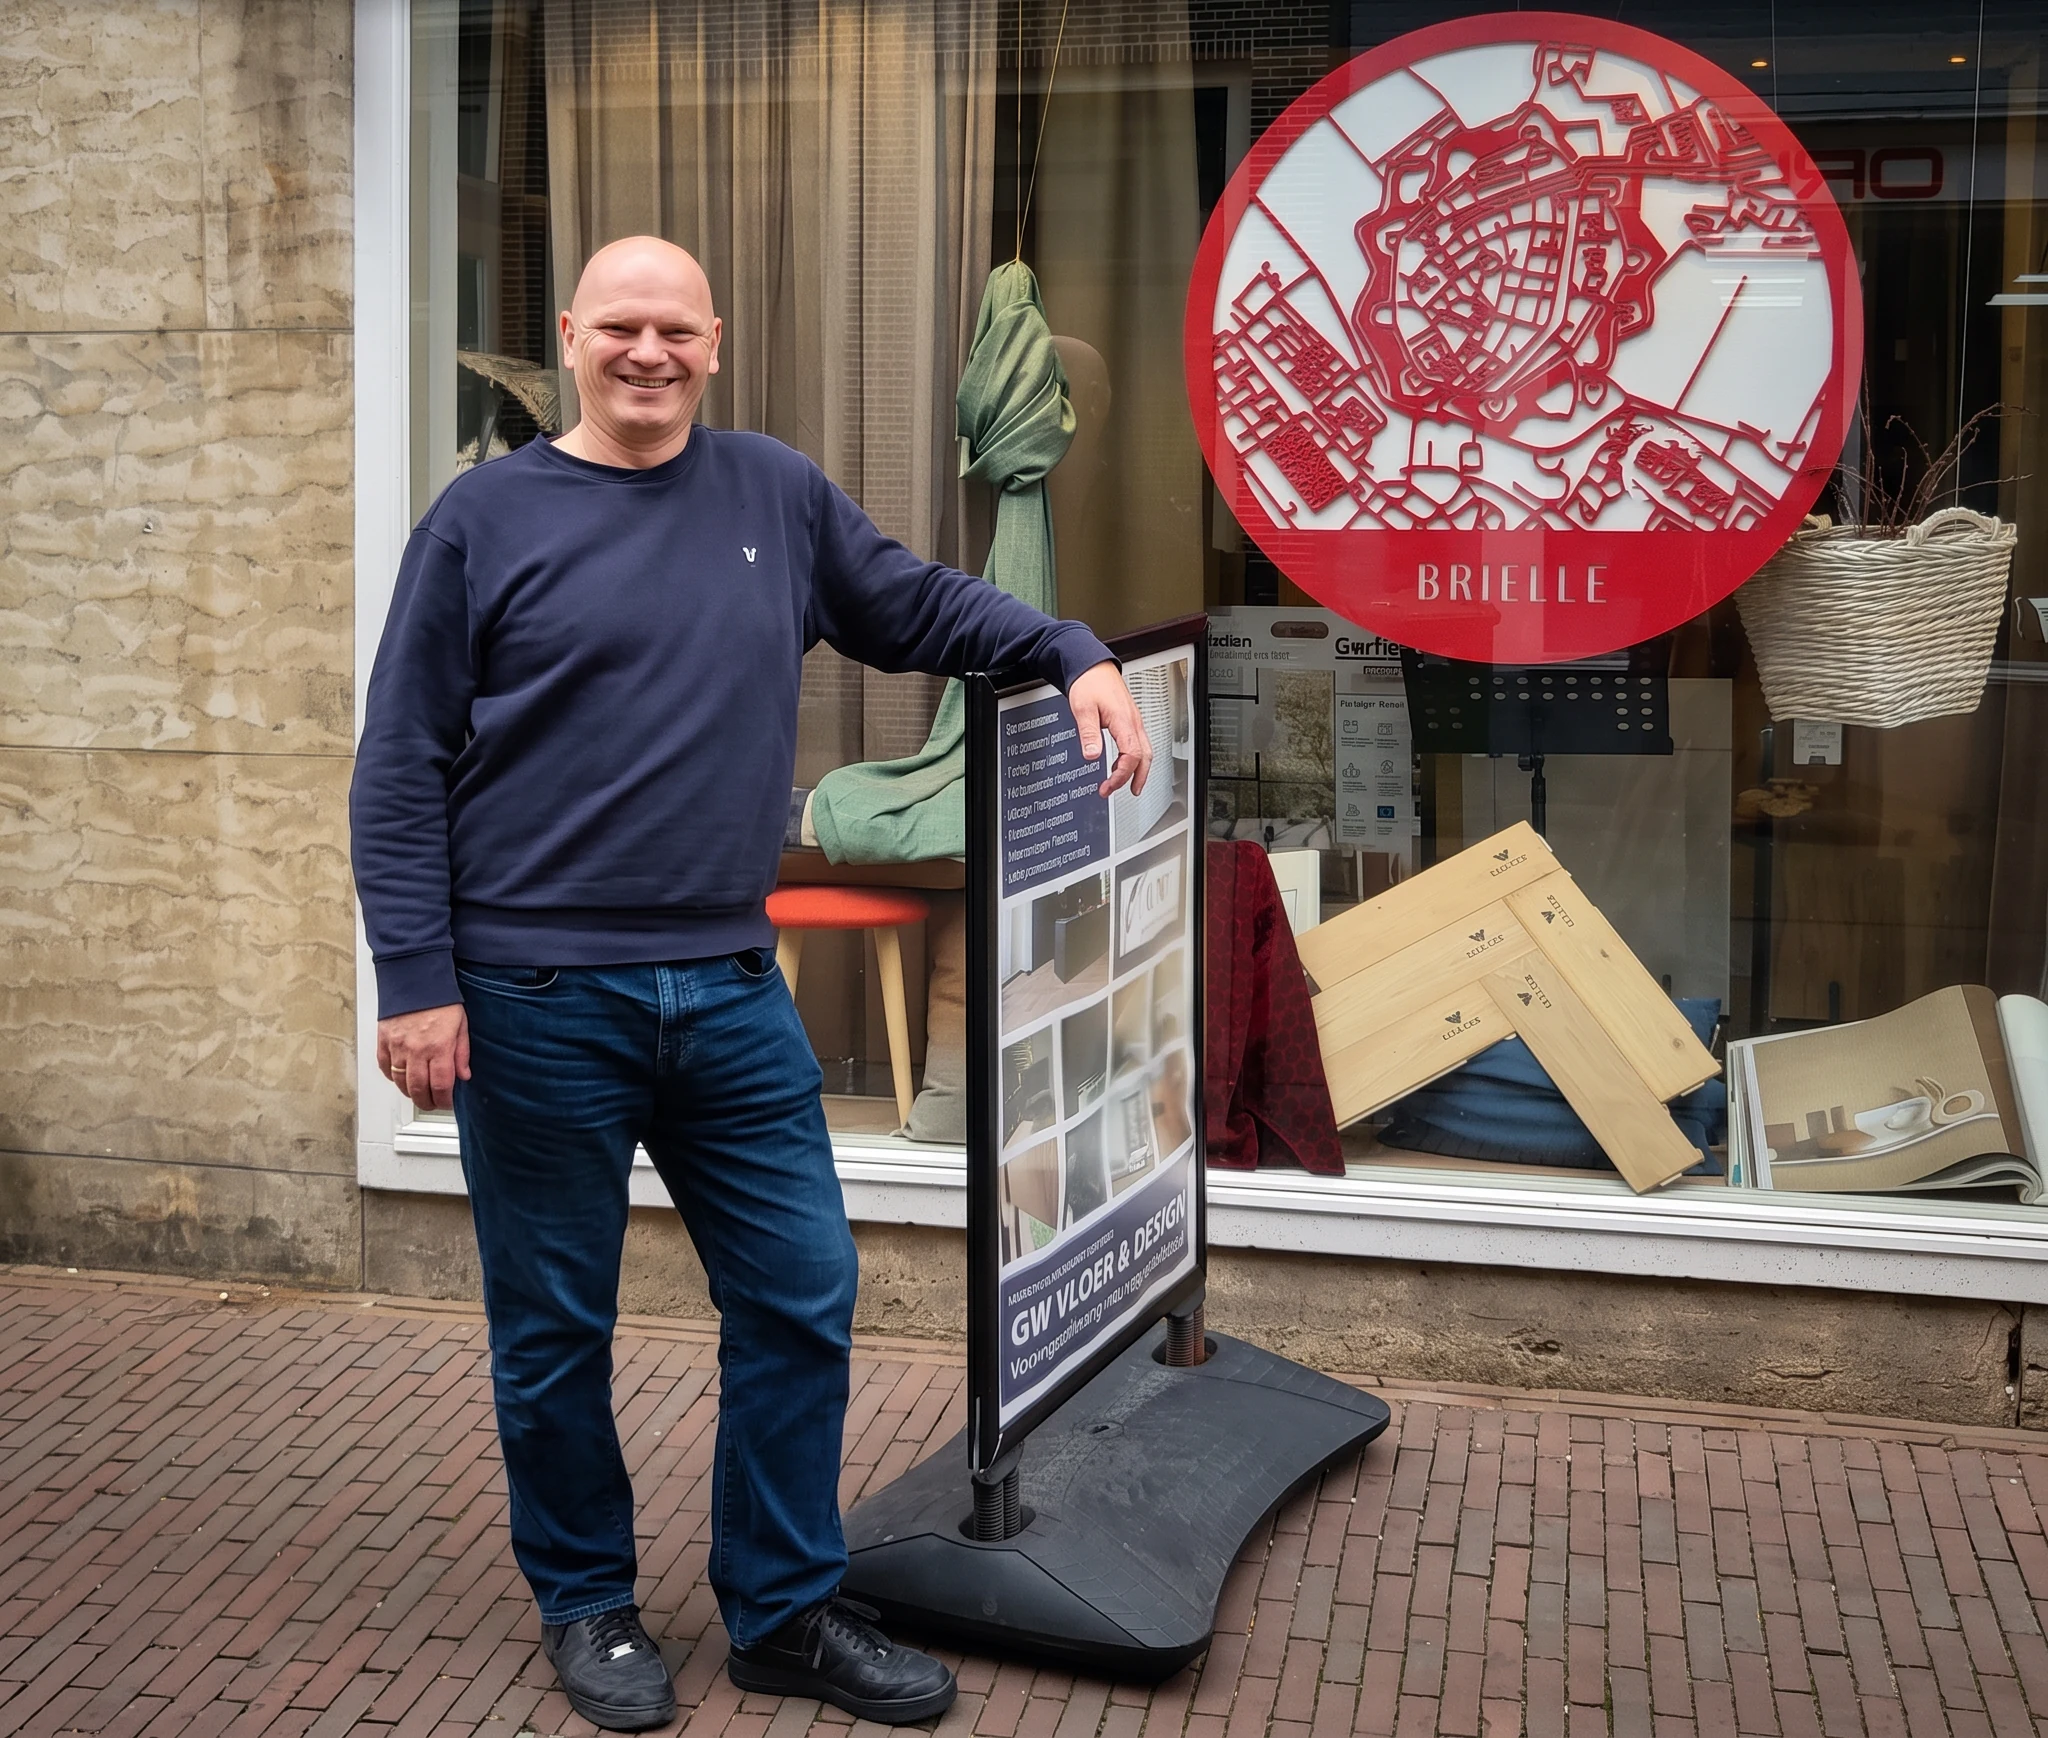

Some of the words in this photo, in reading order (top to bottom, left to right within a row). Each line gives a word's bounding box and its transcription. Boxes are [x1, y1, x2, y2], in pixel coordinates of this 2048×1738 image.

[1417, 563, 1608, 604] BRIELLE
[1011, 1296, 1053, 1346] GW
[1056, 1250, 1115, 1320] VLOER
[1117, 1239, 1131, 1273] &
[1133, 1188, 1187, 1261] DESIGN
